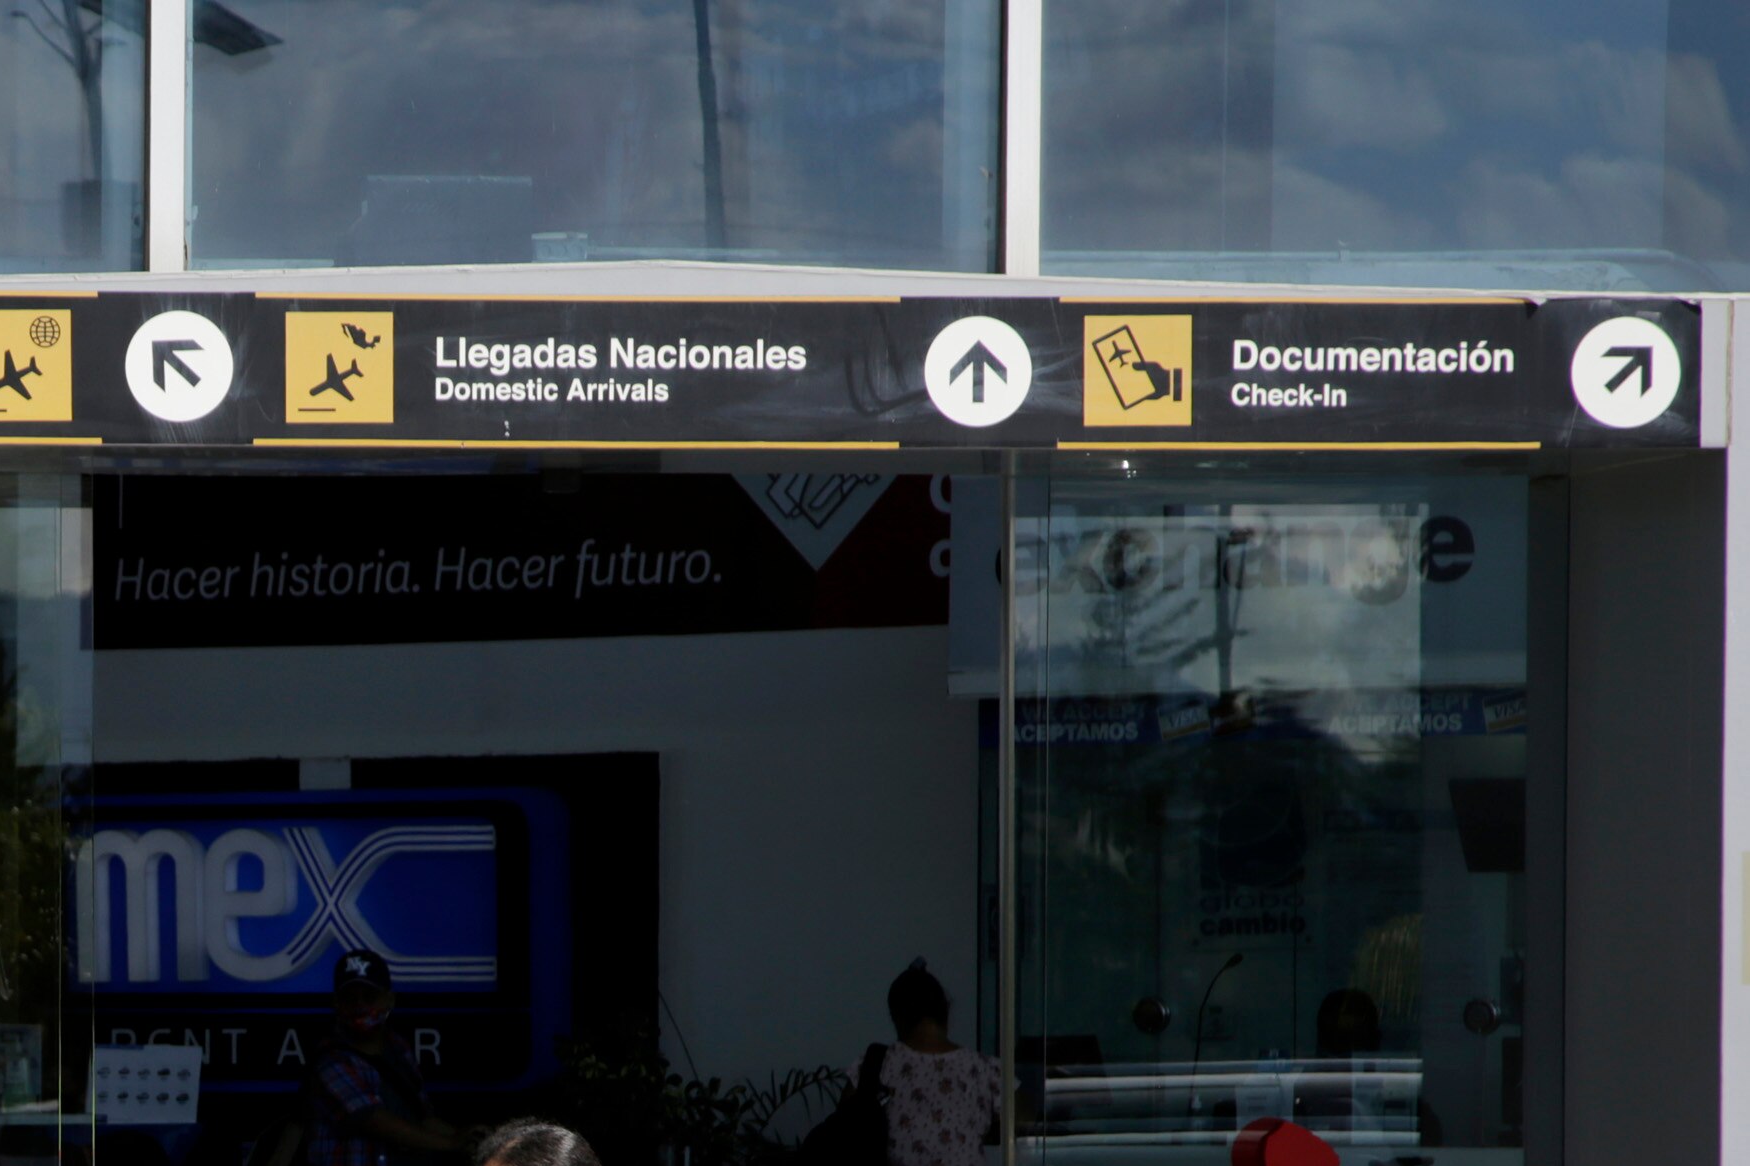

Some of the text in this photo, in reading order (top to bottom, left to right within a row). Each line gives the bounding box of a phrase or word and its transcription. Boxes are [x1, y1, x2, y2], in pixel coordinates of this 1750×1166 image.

[435, 337, 807, 376] Llegadas Nacionales
[1232, 339, 1515, 373] Documentación
[434, 377, 670, 402] Domestic Arrivals
[1231, 382, 1348, 407] Check-In
[115, 539, 723, 600] Hacer historia. Hacer futuro.
[1199, 912, 1306, 938] cambio
